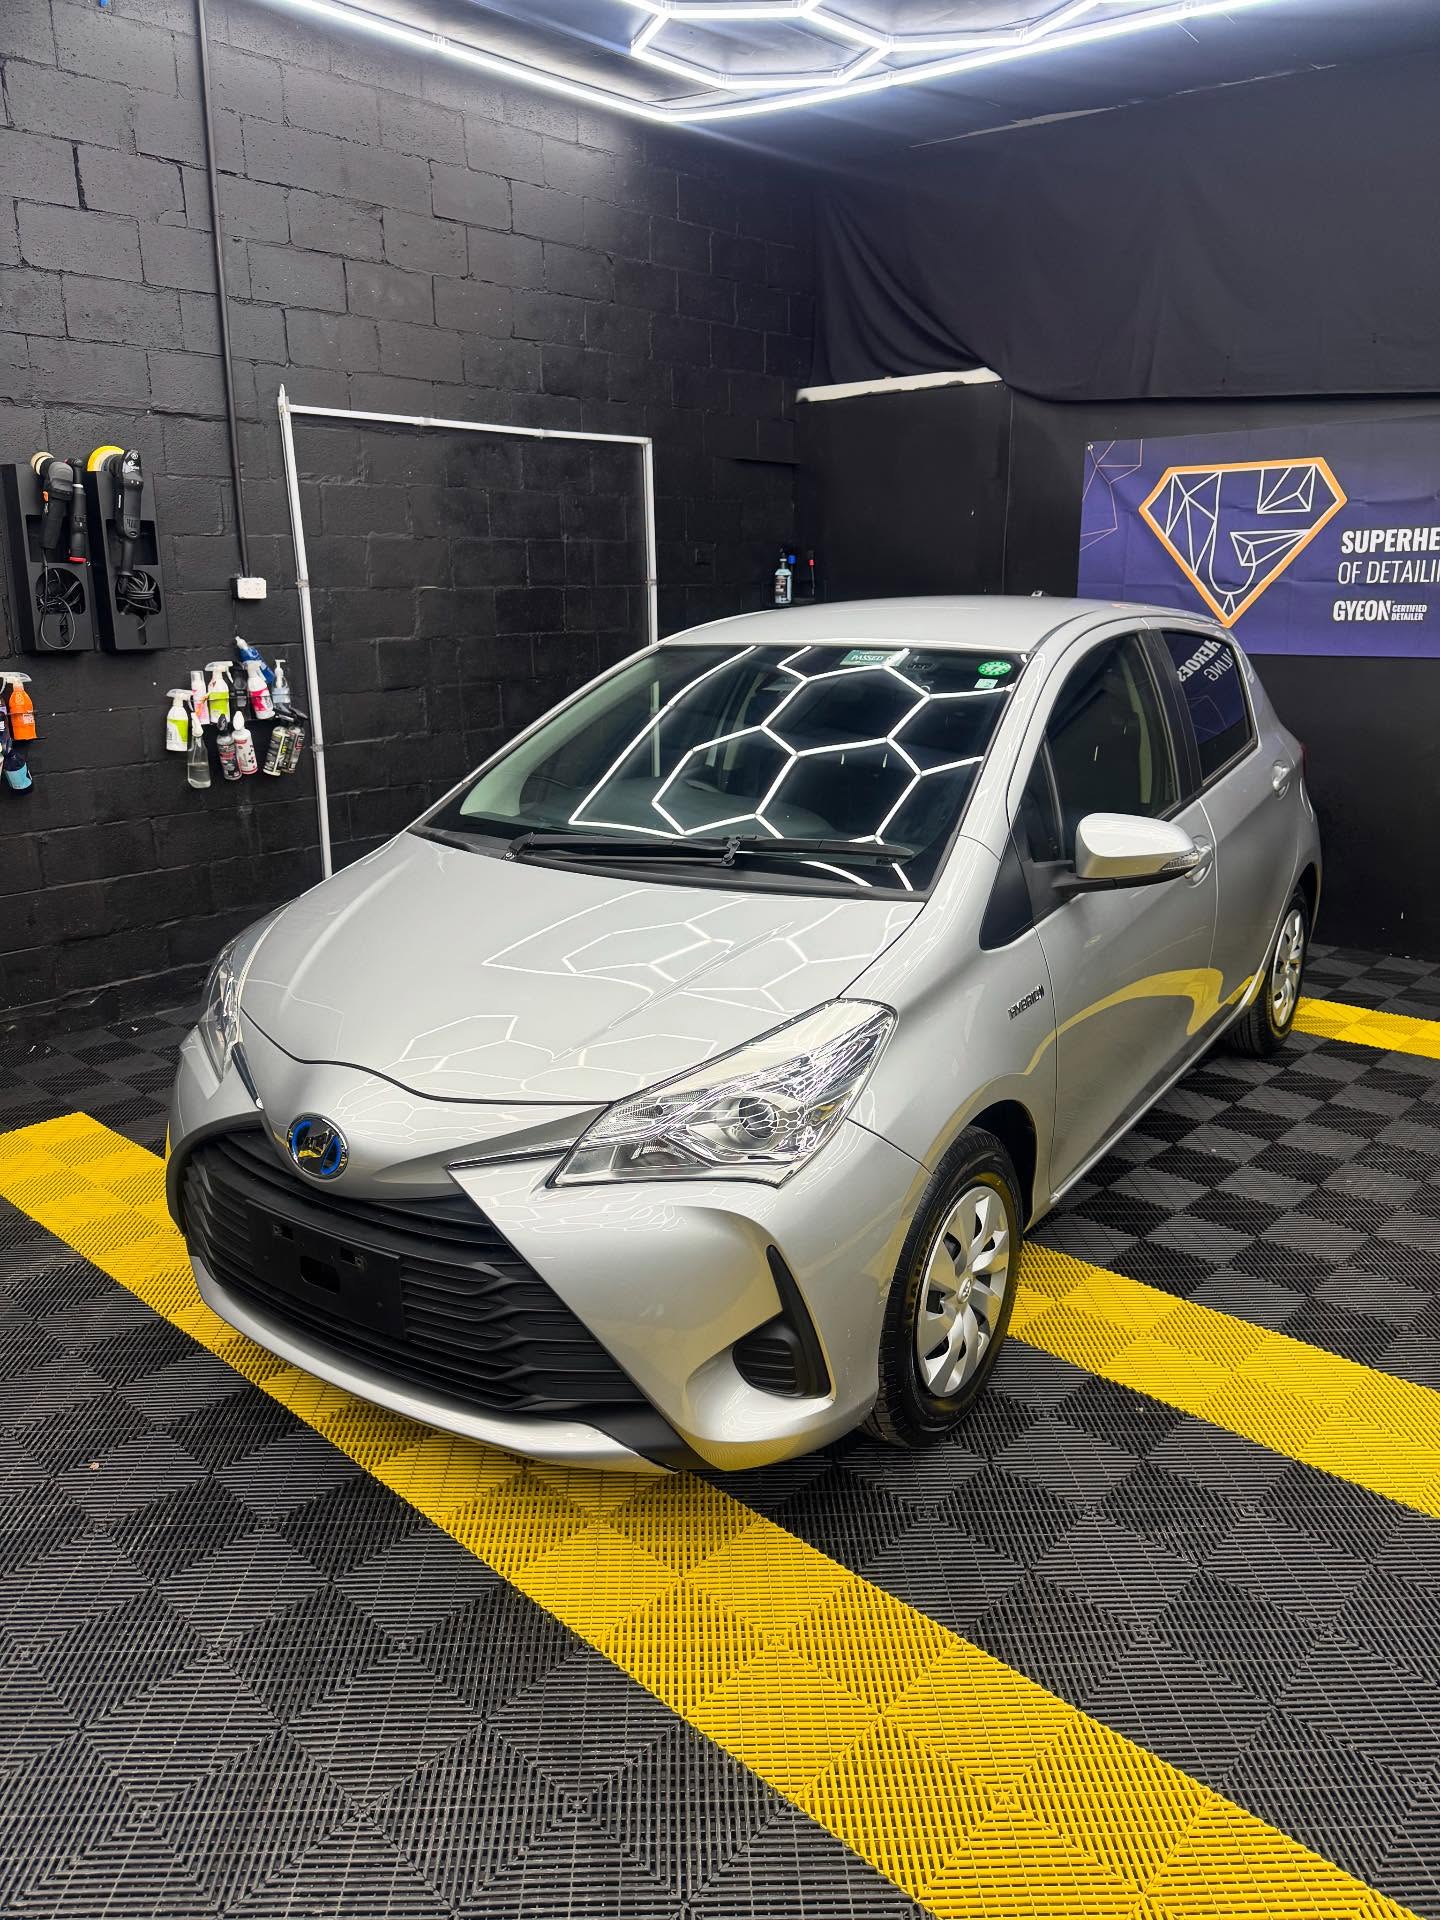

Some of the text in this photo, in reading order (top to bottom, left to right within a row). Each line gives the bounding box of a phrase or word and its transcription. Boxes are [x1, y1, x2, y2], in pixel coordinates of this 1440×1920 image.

[1338, 561, 1362, 584] OF
[1333, 599, 1391, 621] GYEON
[1391, 604, 1428, 613] CERTIFIED
[1390, 613, 1424, 621] DETAILER
